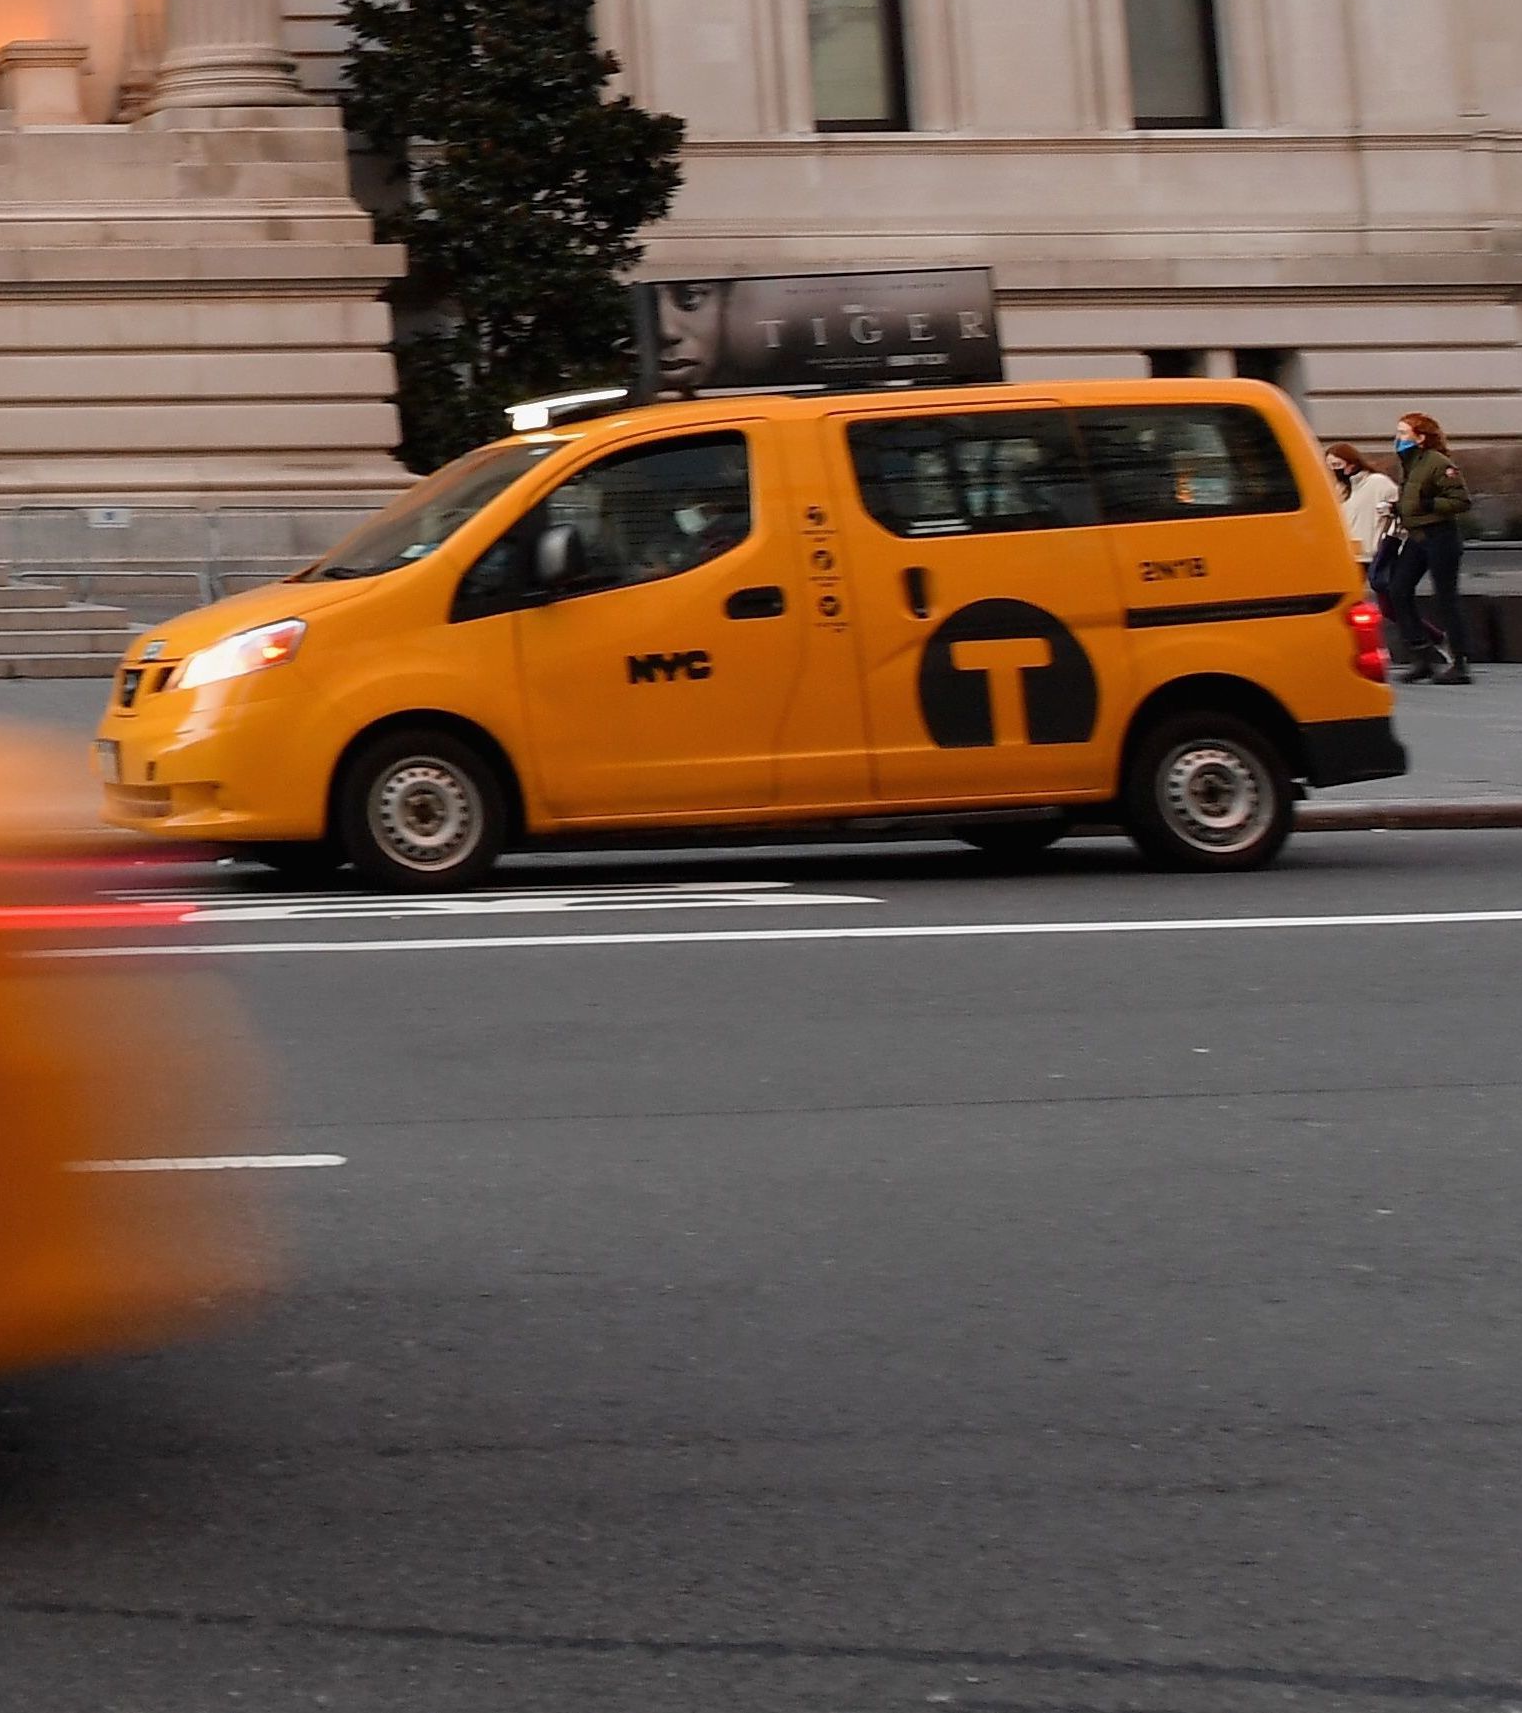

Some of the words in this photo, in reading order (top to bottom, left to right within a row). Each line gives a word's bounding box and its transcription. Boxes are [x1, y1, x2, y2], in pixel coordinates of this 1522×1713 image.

[756, 309, 991, 349] TIGER
[625, 650, 713, 685] NYC
[950, 637, 1054, 747] T
